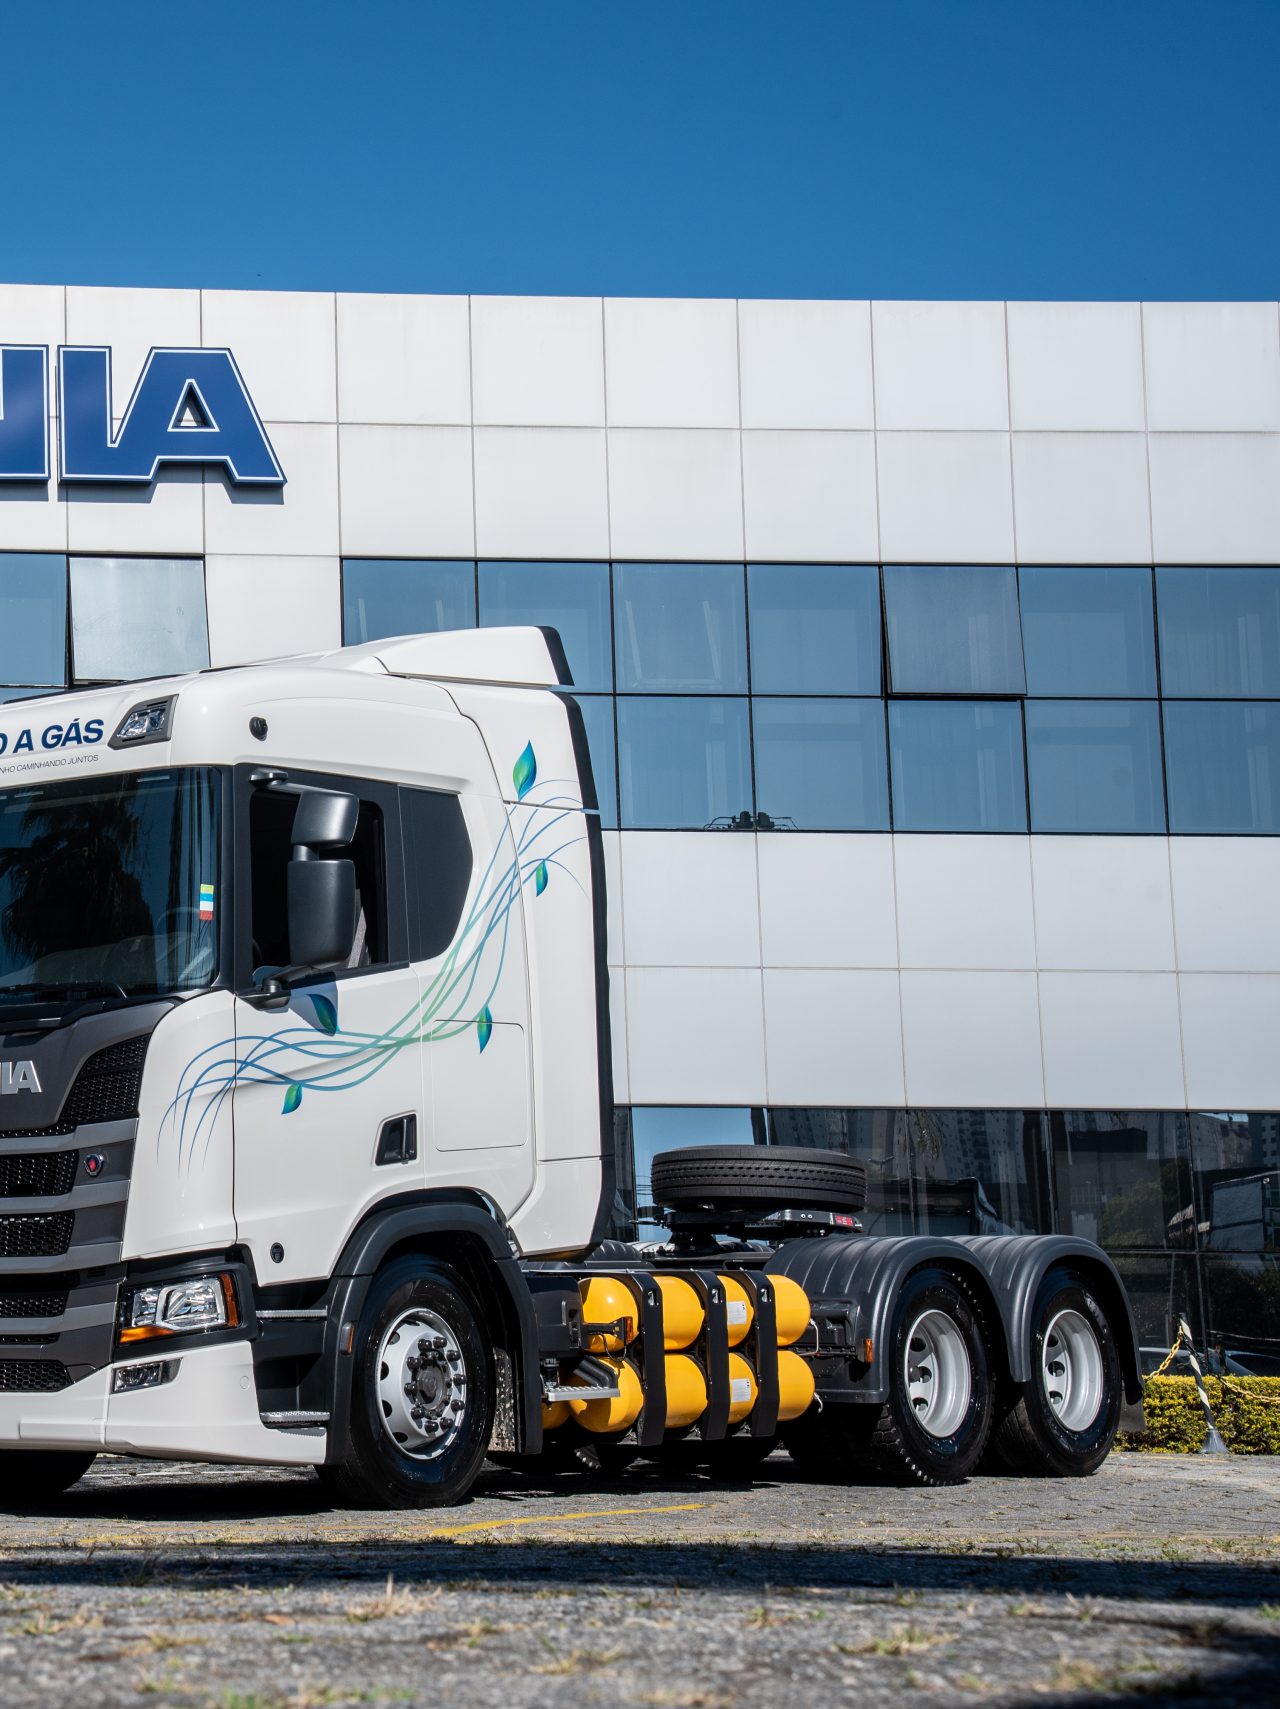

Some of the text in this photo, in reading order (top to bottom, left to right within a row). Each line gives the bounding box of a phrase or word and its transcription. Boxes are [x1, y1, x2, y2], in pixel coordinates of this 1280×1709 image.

[12, 728, 34, 754] A
[41, 717, 105, 750] GÁS
[16, 758, 67, 771] CAMINHANDO
[67, 754, 99, 766] JUNTOS
